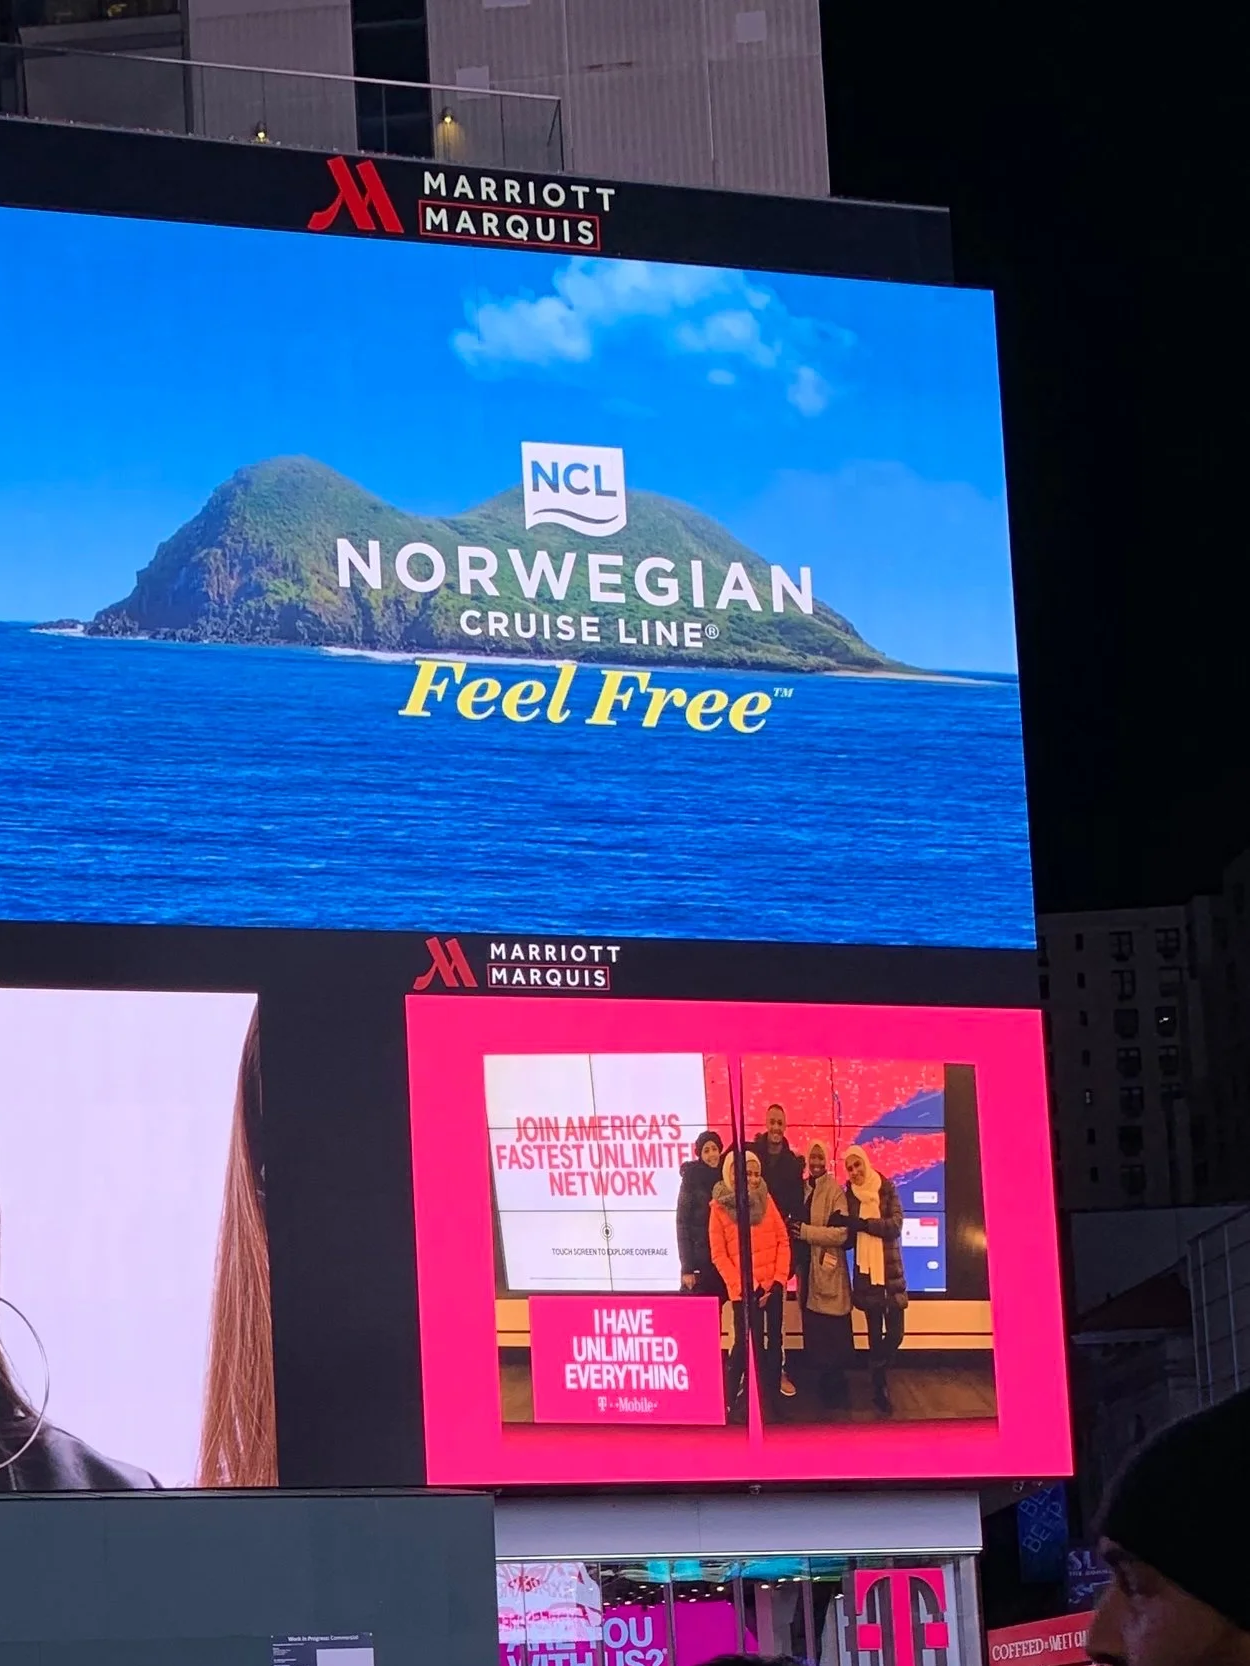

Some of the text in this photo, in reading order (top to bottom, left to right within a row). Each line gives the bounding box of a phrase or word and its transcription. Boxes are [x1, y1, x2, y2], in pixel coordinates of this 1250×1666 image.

[423, 170, 616, 212] MARRIOTT
[425, 207, 595, 246] MARQUIS
[530, 460, 618, 498] NCL
[336, 537, 815, 615] NORWEGIAN
[459, 609, 601, 644] CRUISE
[398, 658, 577, 724] Feel
[490, 942, 621, 963] MARRIOTT
[491, 967, 607, 987] MARQUIS
[516, 1114, 681, 1143] JOIN AMERICA'S
[496, 1144, 584, 1169] FASTEST
[550, 1171, 657, 1196] NETWORK
[551, 1247, 668, 1256] TOUCH SCREEN TO EXPLORE COVERAGE
[593, 1308, 654, 1334] I HAVE
[572, 1336, 678, 1362] UNLIMITED
[564, 1363, 689, 1390] EVERYTHING
[992, 1638, 1043, 1661] COFFEED
[1049, 1632, 1073, 1652] SWEET
